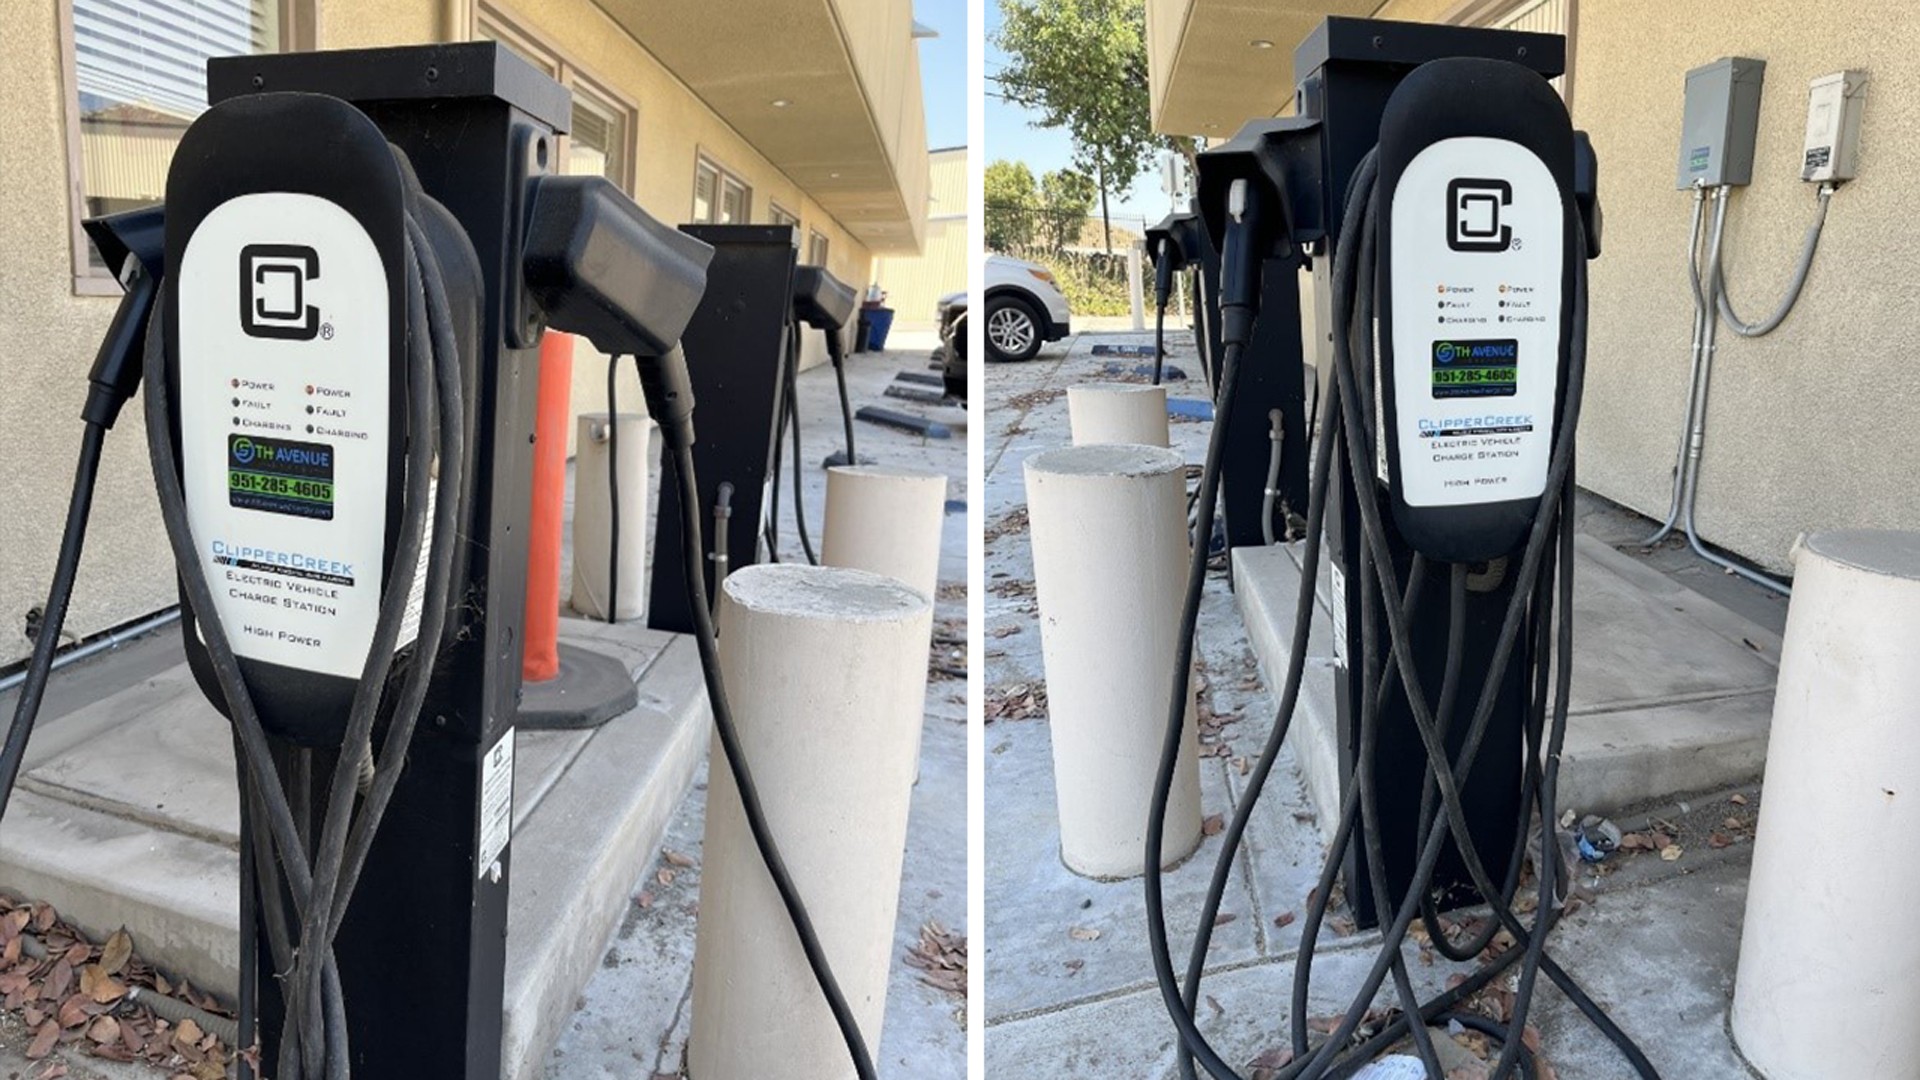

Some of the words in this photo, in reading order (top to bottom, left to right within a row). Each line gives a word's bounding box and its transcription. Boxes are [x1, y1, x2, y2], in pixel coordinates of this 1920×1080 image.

[1472, 344, 1515, 358] AVENUE
[1434, 369, 1515, 383] 951-285-4605
[241, 379, 275, 391] POWER
[316, 386, 351, 398] POWER
[242, 399, 271, 410] FAULT
[316, 405, 347, 418] FAULT
[316, 425, 369, 440] CHARGING
[275, 447, 330, 467] AVENUE
[1432, 453, 1473, 462] CHARGE
[1477, 450, 1519, 460] STATION
[231, 472, 331, 500] 951-285-4605
[226, 570, 282, 589] ELECTRIC
[286, 580, 339, 599] VEHICLE
[229, 588, 278, 606] CHARGE
[283, 597, 337, 617] STATION
[243, 624, 274, 638] HIGH
[278, 630, 322, 648] POWER
